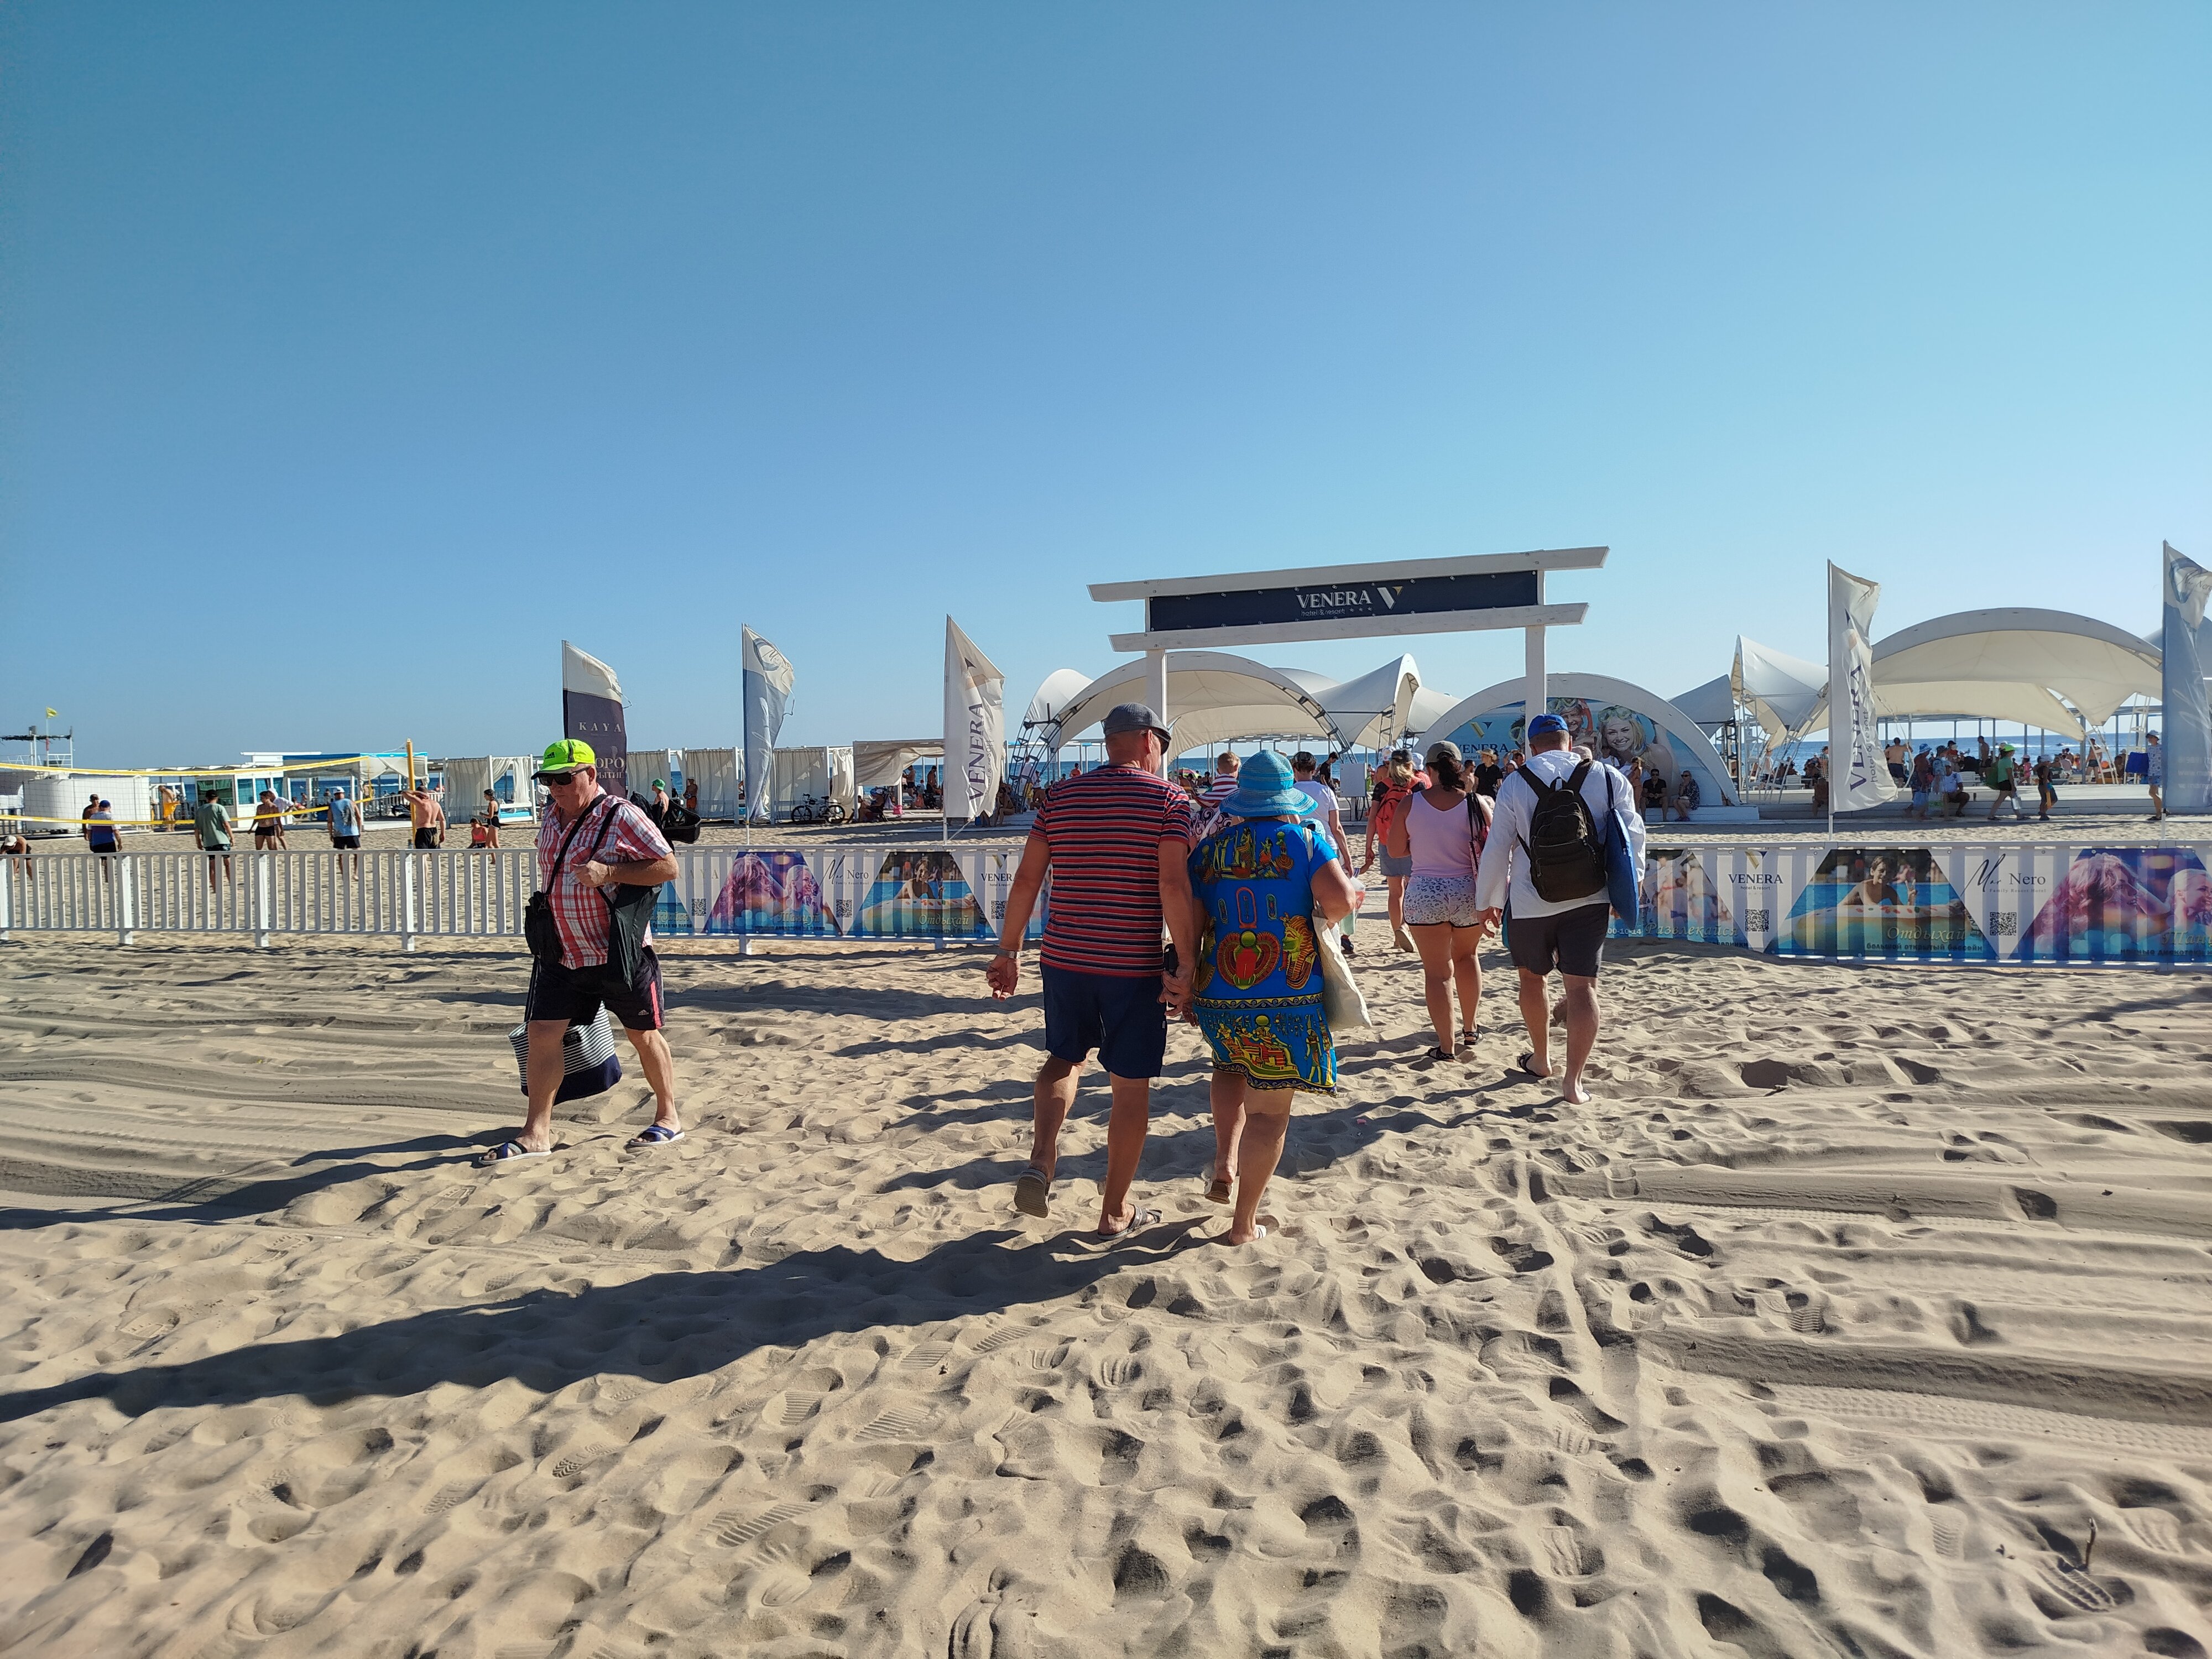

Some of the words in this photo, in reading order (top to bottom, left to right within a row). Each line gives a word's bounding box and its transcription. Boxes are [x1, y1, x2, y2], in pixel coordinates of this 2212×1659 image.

[1296, 590, 1373, 608] VENERA
[579, 722, 622, 732] KAYA
[968, 703, 985, 800] VENERA
[1867, 753, 1878, 782] hotel
[847, 870, 869, 879] Nero
[1728, 874, 1783, 884] VENERA
[2009, 873, 2046, 885] Nero
[919, 913, 969, 927] Отдыхай
[1645, 924, 1738, 938] Развлекайся
[1887, 926, 1965, 943] Отдыхай
